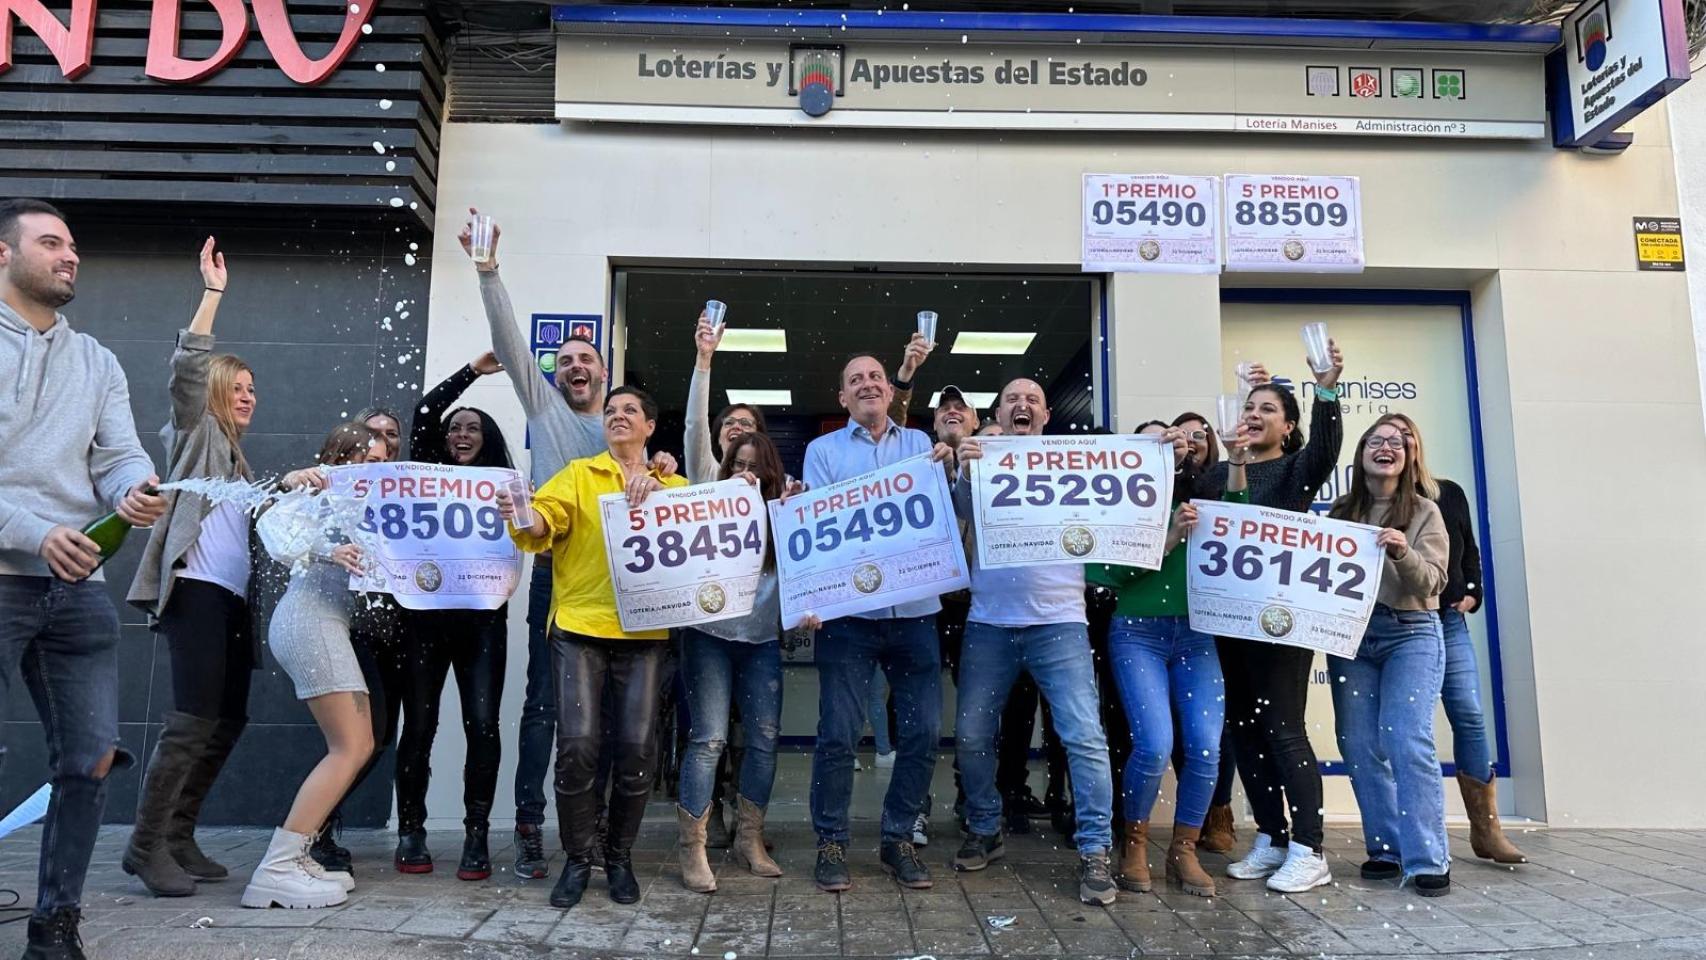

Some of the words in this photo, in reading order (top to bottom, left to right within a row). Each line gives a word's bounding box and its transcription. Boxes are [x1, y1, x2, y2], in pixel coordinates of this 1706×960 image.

[638, 53, 757, 80] Loterías
[766, 62, 783, 87] y
[851, 59, 984, 89] Apuestas
[994, 59, 1038, 85] del
[1049, 61, 1148, 86] Estado
[1620, 55, 1626, 70] y
[1627, 56, 1643, 77] del
[1291, 119, 1337, 130] Manises
[1356, 120, 1441, 132] Administración
[1459, 123, 1466, 133] 3
[1117, 183, 1196, 199] PREMIO
[1261, 184, 1339, 200] PREMIO
[1092, 199, 1206, 227] 05490
[1235, 200, 1348, 227] 88509
[1303, 401, 1389, 414] lería
[1027, 450, 1143, 471] PREMIO
[381, 477, 496, 501] PREMIO
[813, 472, 914, 519] PREMIO
[990, 473, 1157, 508] 25296
[655, 496, 752, 528] PREMIO
[1260, 510, 1295, 522] VENDIDO
[787, 493, 935, 562] 05490
[1239, 520, 1358, 558] PREMIO
[622, 520, 762, 574] 38454
[1024, 540, 1054, 548] NAVIDAD
[1198, 540, 1366, 601] 36142
[661, 601, 692, 610] NAVIDAD
